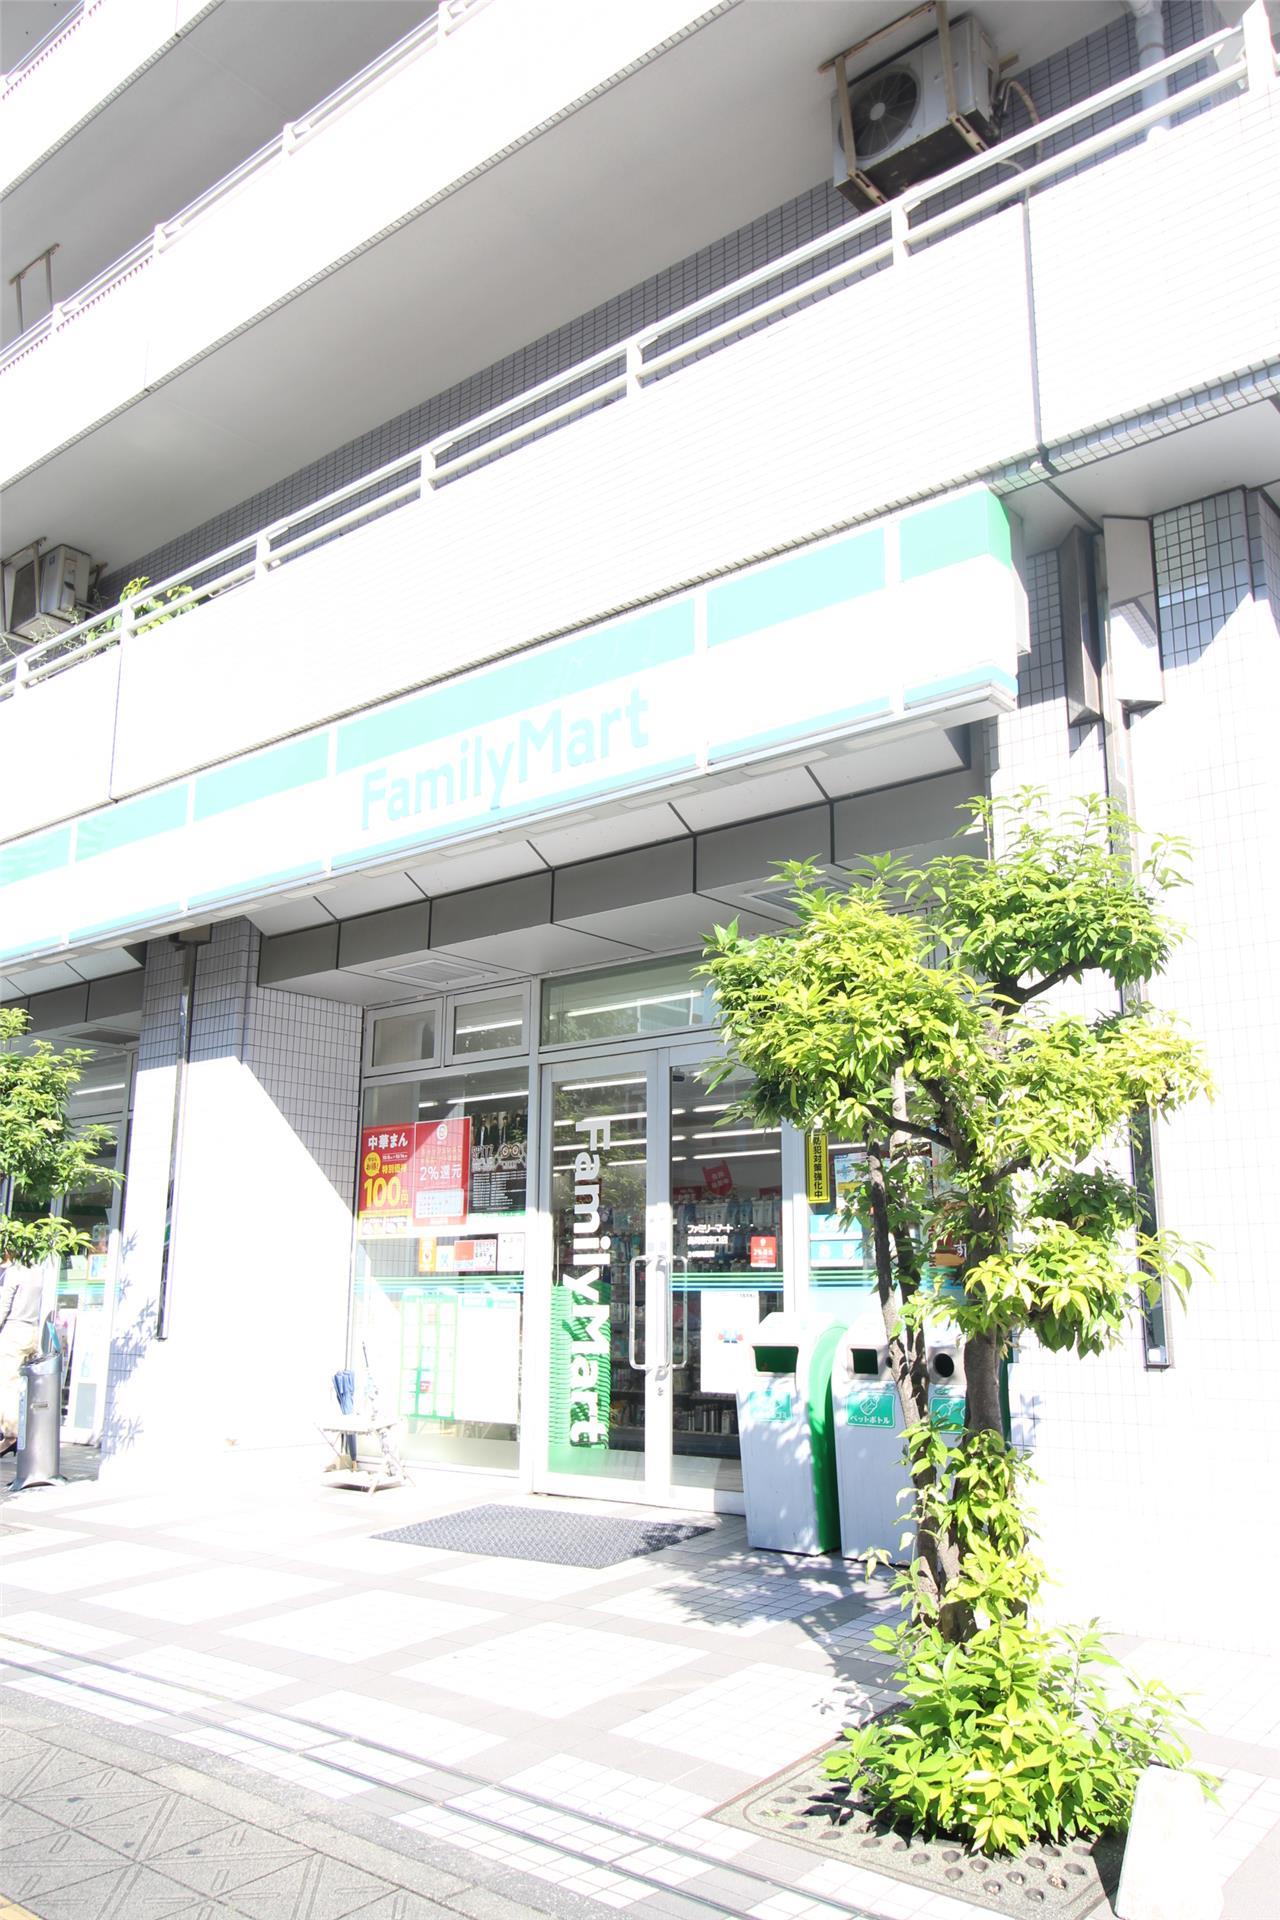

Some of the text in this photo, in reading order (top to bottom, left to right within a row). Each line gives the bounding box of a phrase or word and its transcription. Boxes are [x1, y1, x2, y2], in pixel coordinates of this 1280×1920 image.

[361, 687, 651, 831] FamilyMart
[368, 1133, 408, 1150] 中華まん
[687, 1224, 733, 1233] ファミリーマート
[562, 1119, 611, 1449] FamilyMart
[849, 1414, 891, 1425] ペットボトル
